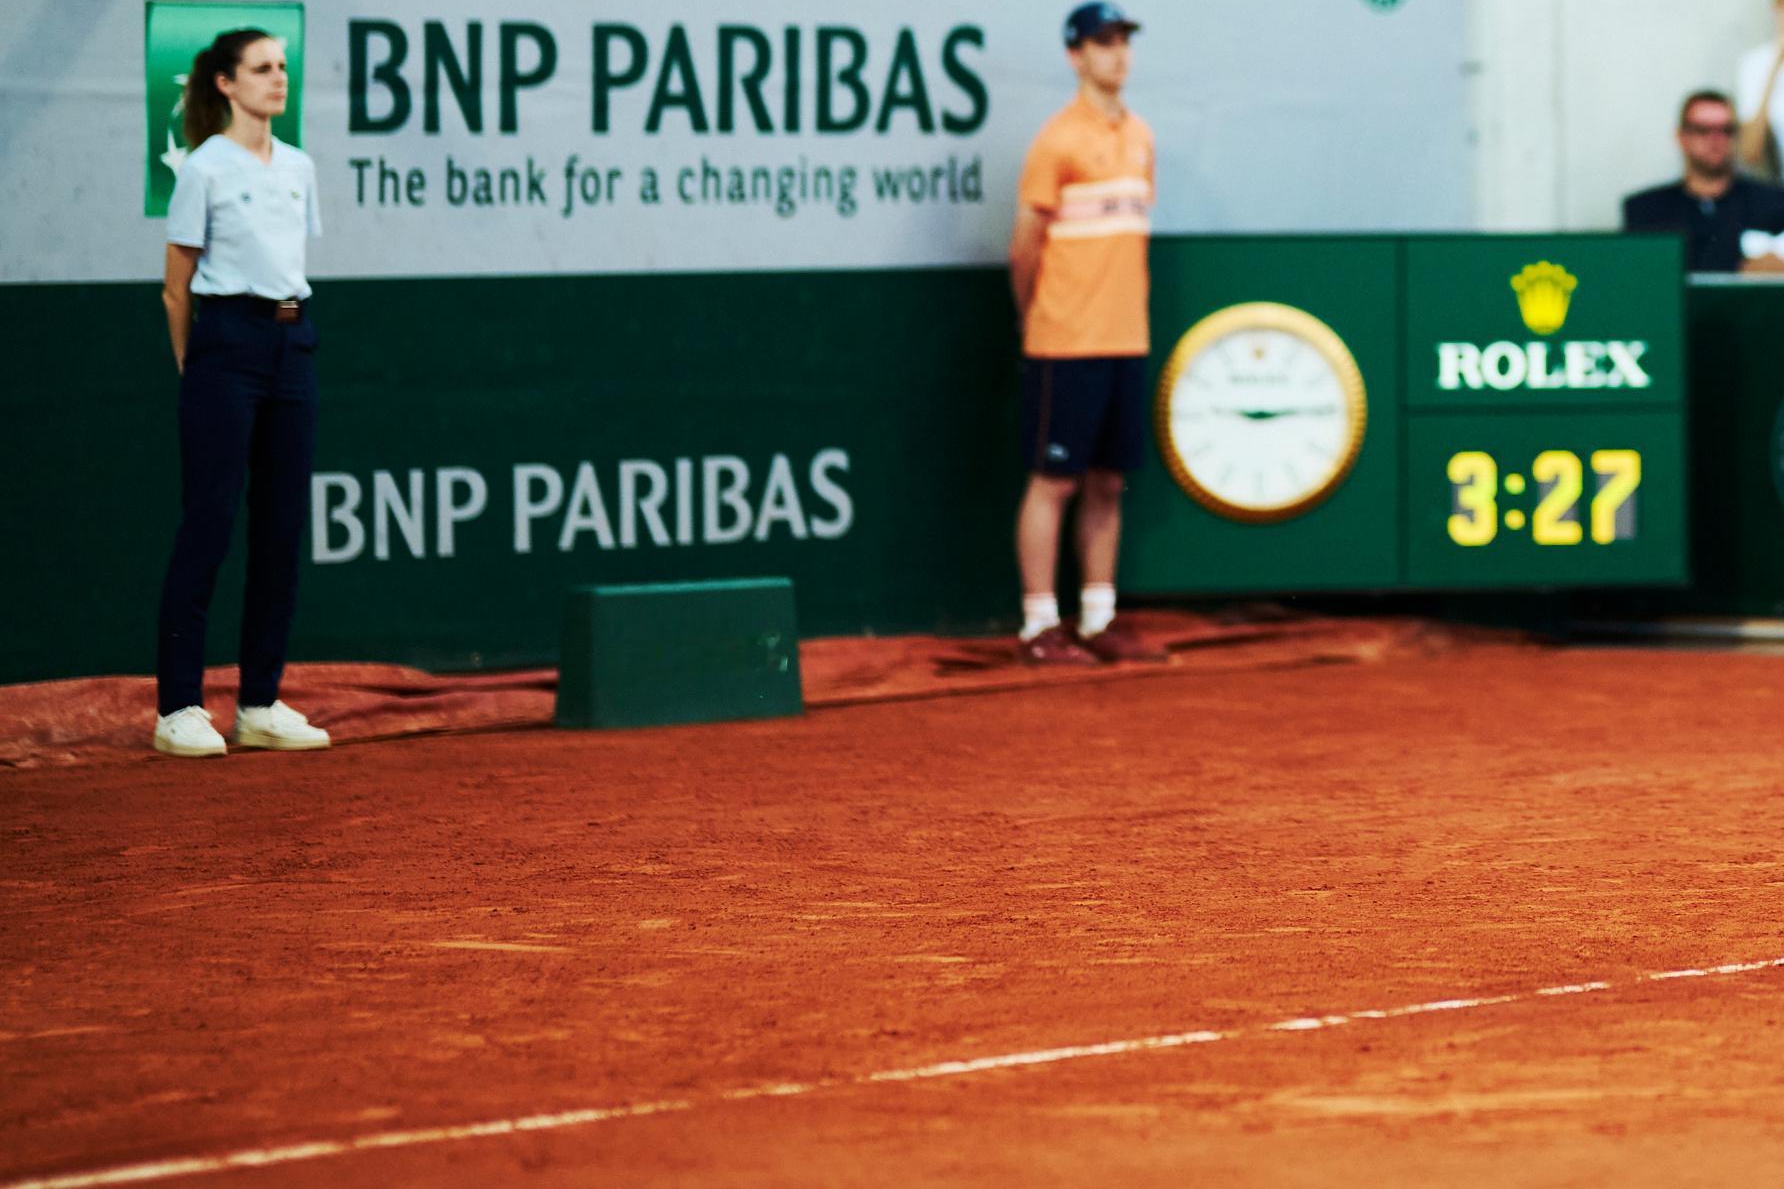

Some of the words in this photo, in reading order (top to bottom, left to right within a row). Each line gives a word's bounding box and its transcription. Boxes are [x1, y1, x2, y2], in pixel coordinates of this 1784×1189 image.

[347, 18, 559, 136] BNP
[591, 22, 989, 137] PARIBAS
[347, 156, 427, 208] The
[445, 154, 547, 208] bank
[561, 154, 623, 219] for
[639, 167, 660, 204] a
[677, 157, 857, 218] changing
[873, 155, 984, 205] world
[1437, 340, 1650, 390] ROLEX
[311, 467, 489, 563] BNP
[513, 448, 854, 554] PARIBAS
[1446, 449, 1643, 547] 3:27
